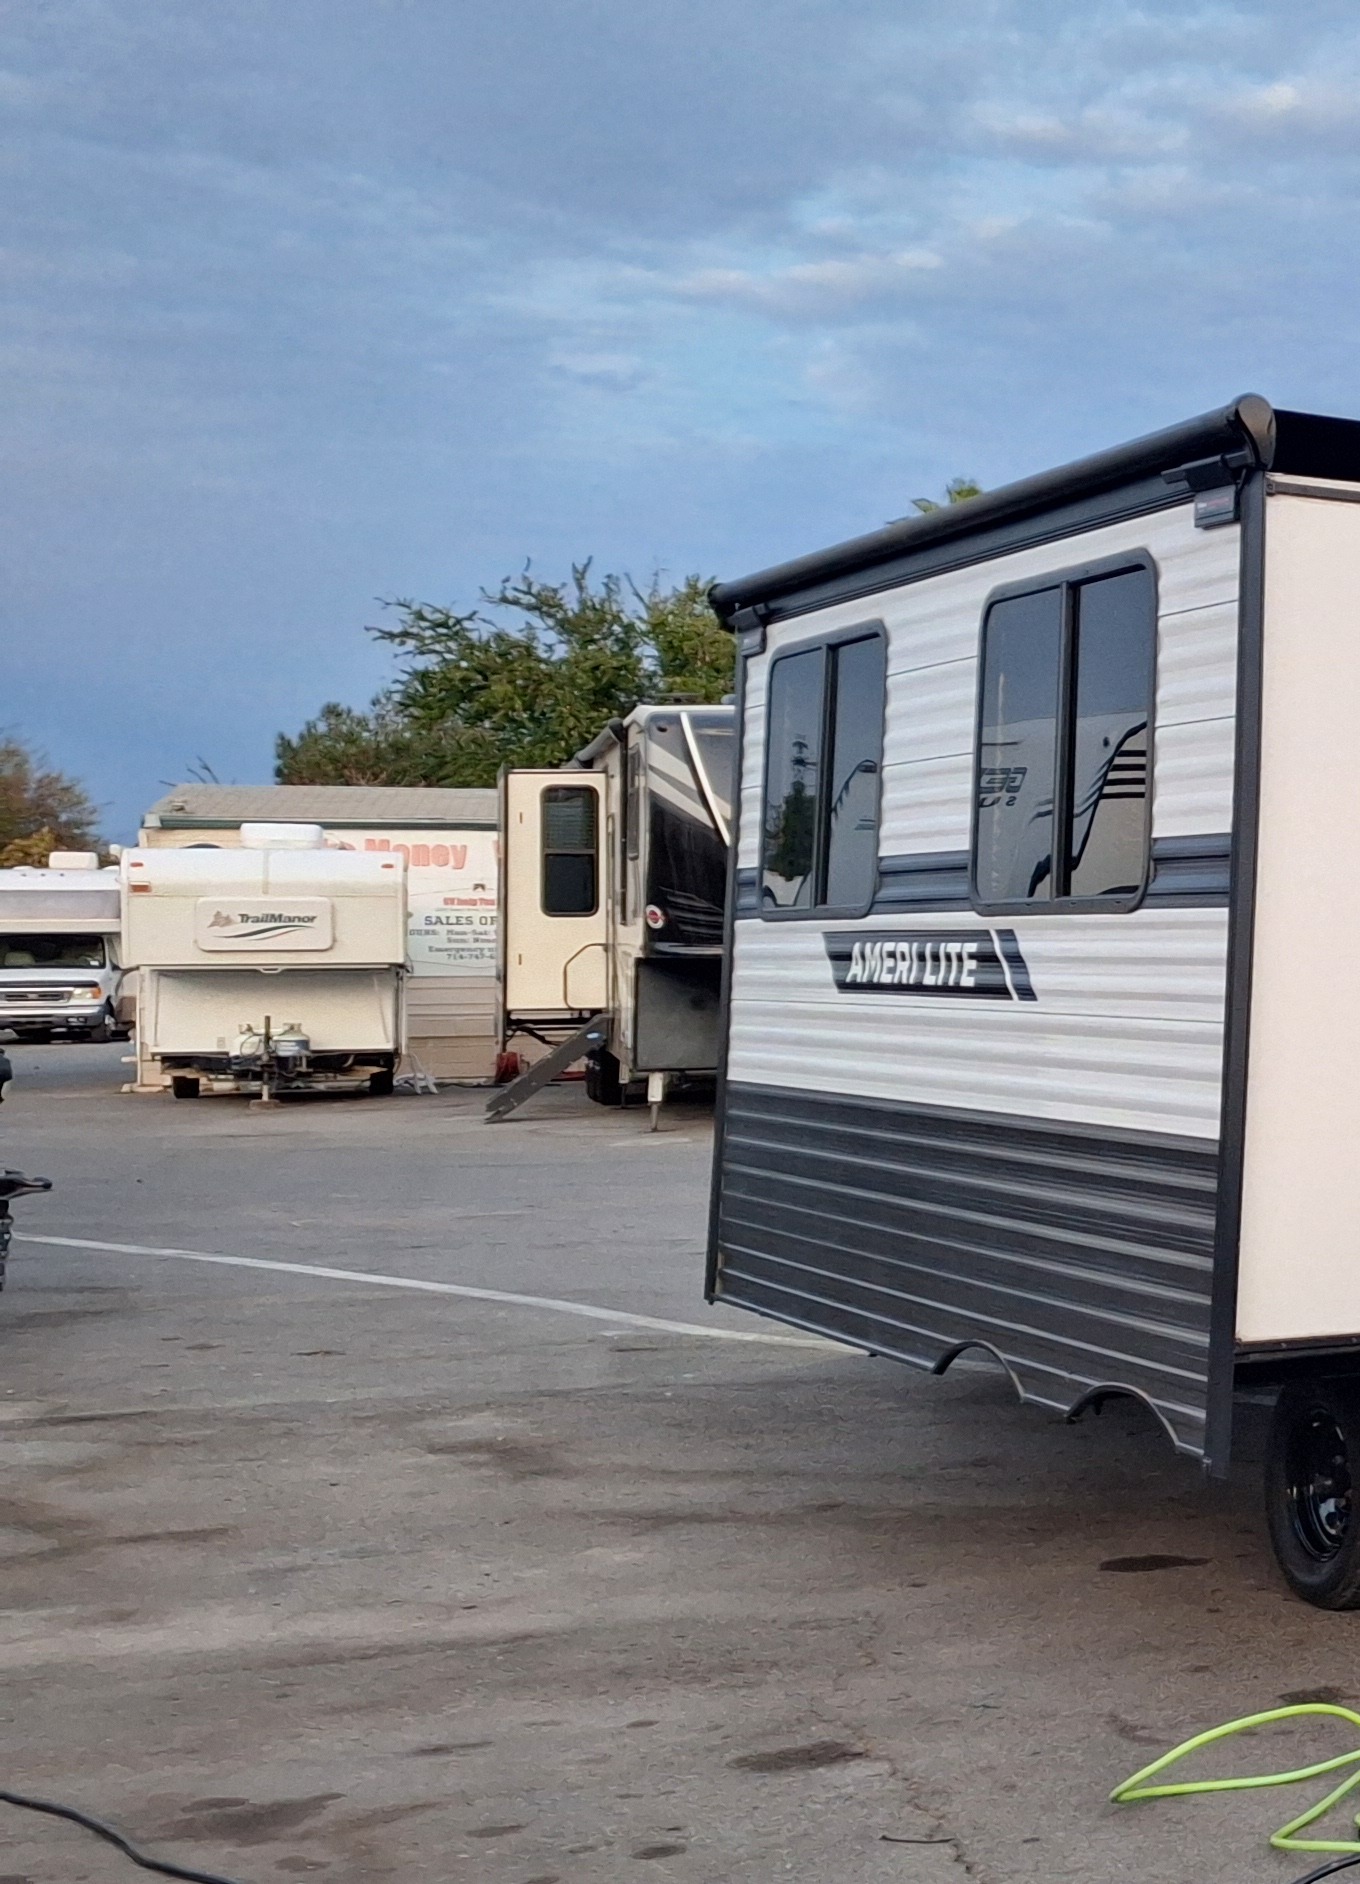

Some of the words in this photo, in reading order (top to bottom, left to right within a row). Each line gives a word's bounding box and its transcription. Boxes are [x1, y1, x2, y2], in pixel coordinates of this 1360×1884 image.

[238, 913, 318, 924] TrailManor
[424, 915, 474, 926] SALES
[846, 942, 919, 985] AMERI
[922, 942, 978, 987] LITE
